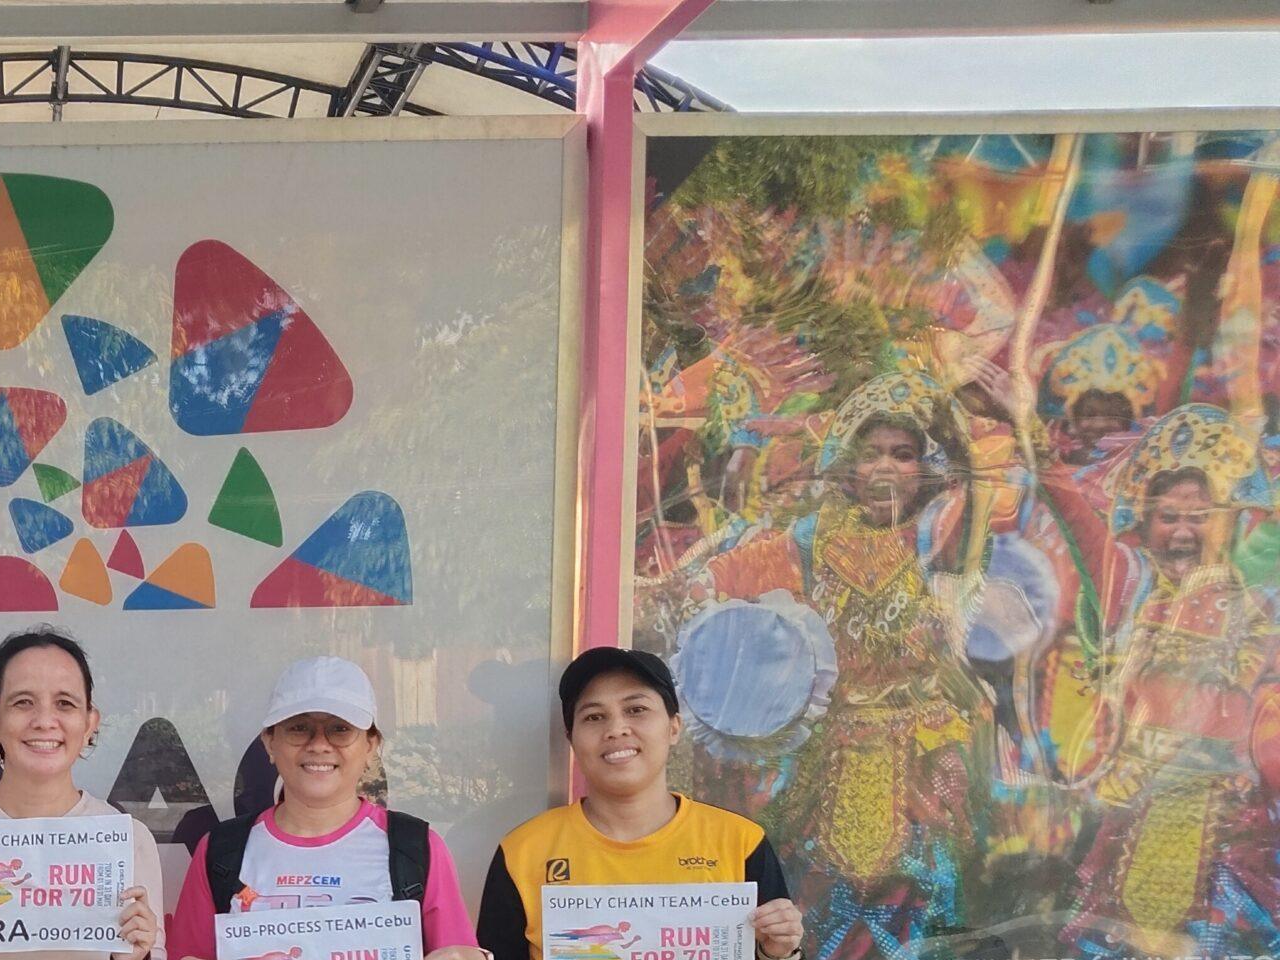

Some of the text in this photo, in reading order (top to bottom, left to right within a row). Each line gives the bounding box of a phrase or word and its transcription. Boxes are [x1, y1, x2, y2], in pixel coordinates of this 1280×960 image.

[1, 833, 45, 846] CHAIN
[49, 830, 129, 845] TEAM-Cebu
[678, 856, 718, 867] brother
[49, 864, 96, 885] RUN
[276, 876, 341, 886] MEPZCEM
[20, 887, 63, 908] FOR
[70, 887, 96, 907] 70
[549, 894, 750, 909] SUPPLY CHAIN TEAM-Cebu
[225, 915, 412, 938] SUB-PROCESS TEAM-Cebu
[660, 927, 711, 947] RUN
